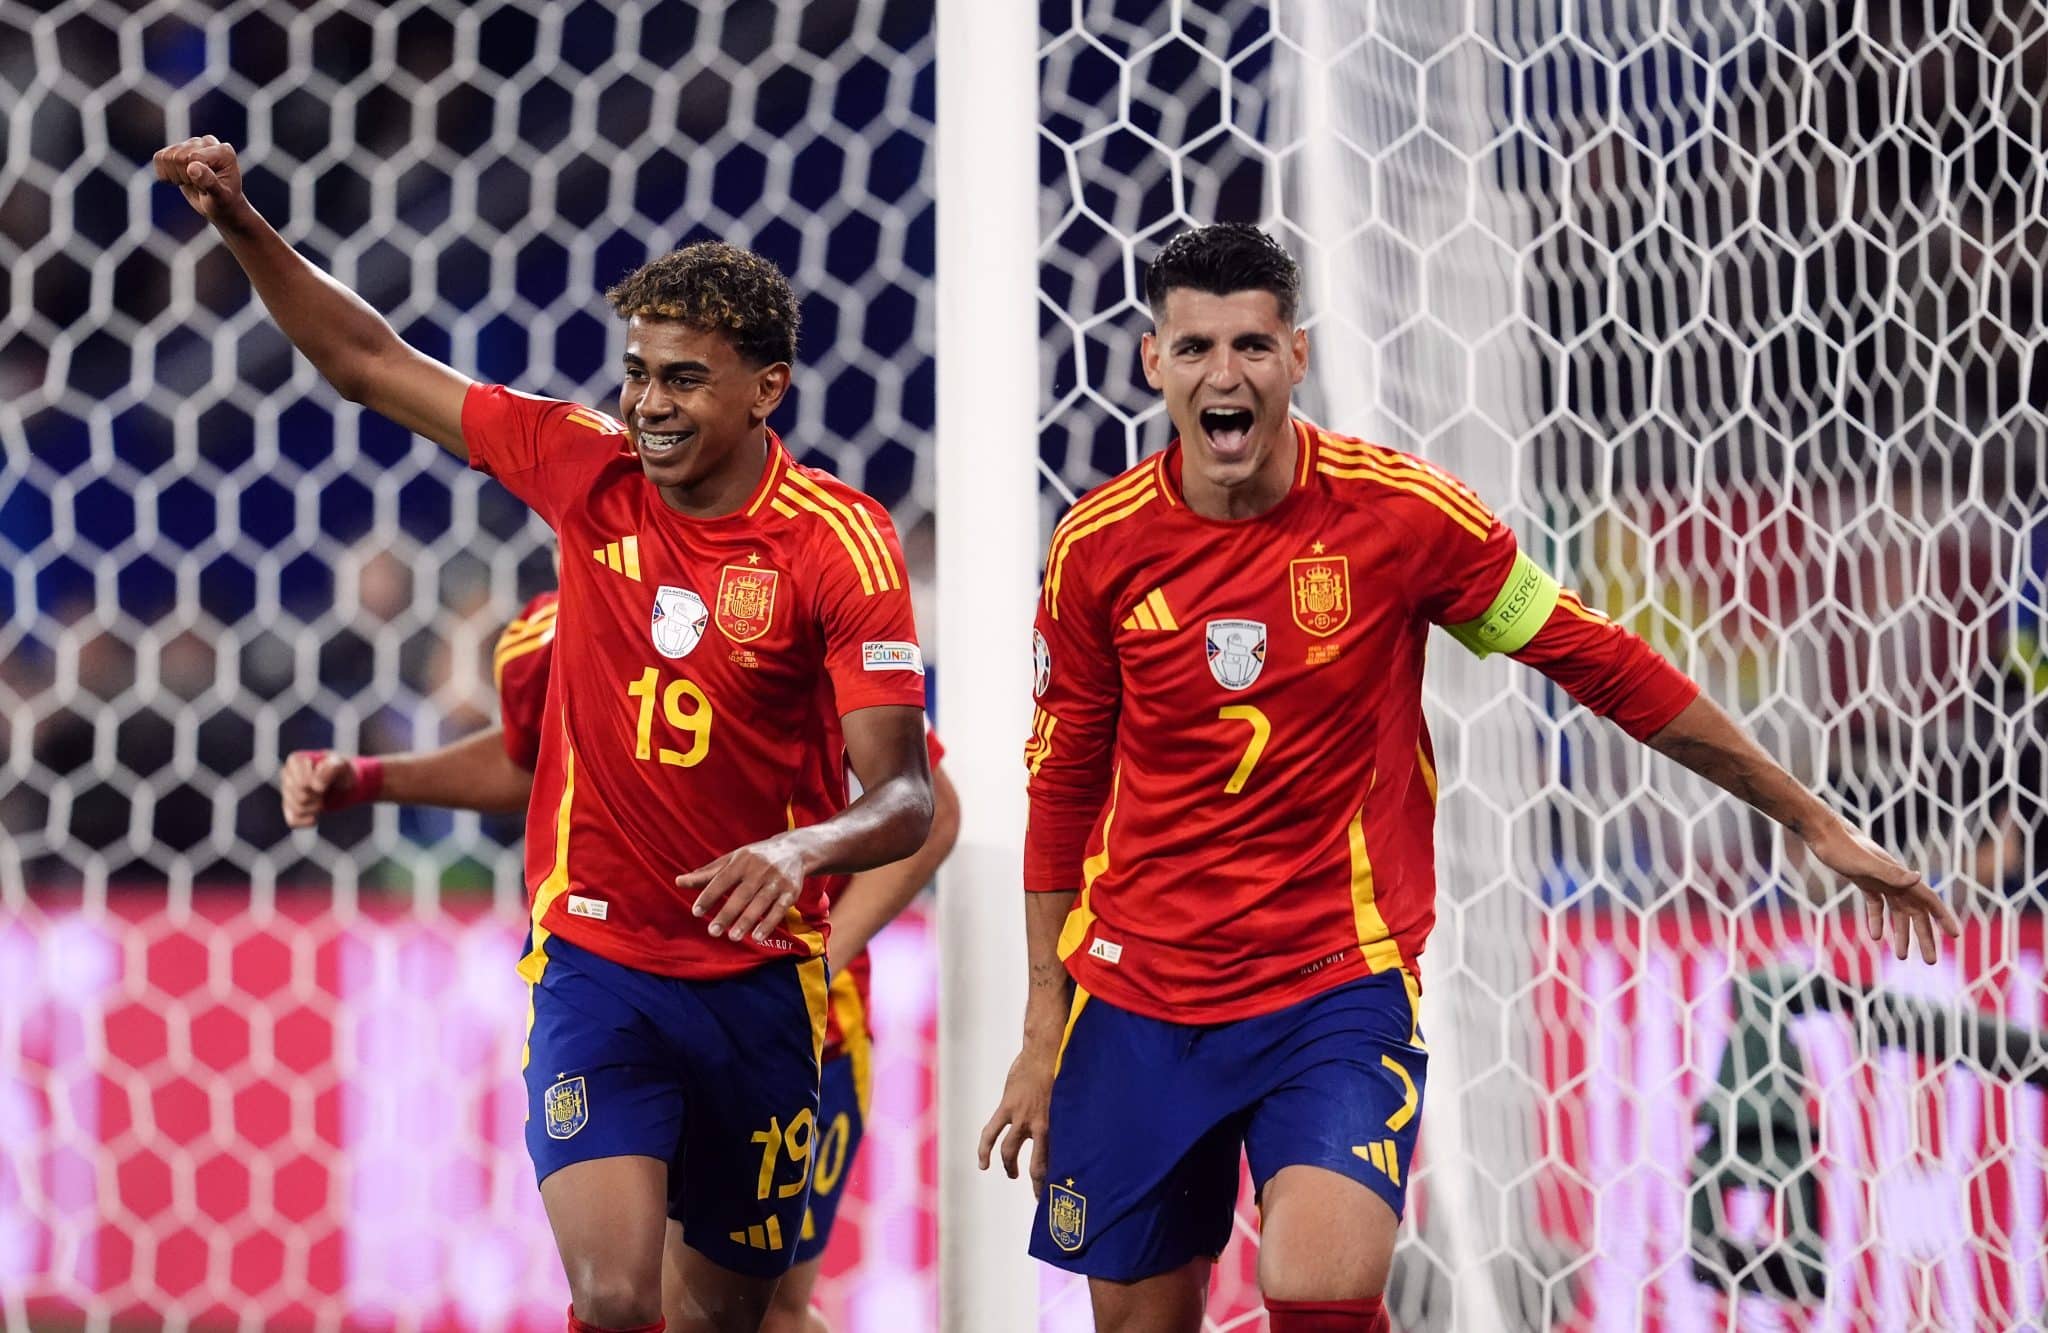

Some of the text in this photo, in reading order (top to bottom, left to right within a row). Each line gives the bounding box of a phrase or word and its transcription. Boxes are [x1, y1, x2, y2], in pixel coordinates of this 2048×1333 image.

[1499, 563, 1538, 623] RESPEC
[627, 666, 713, 768] 19
[1218, 705, 1272, 795] 7
[1381, 1054, 1418, 1132] 7
[750, 1107, 813, 1200] 19
[815, 1112, 850, 1196] 0
